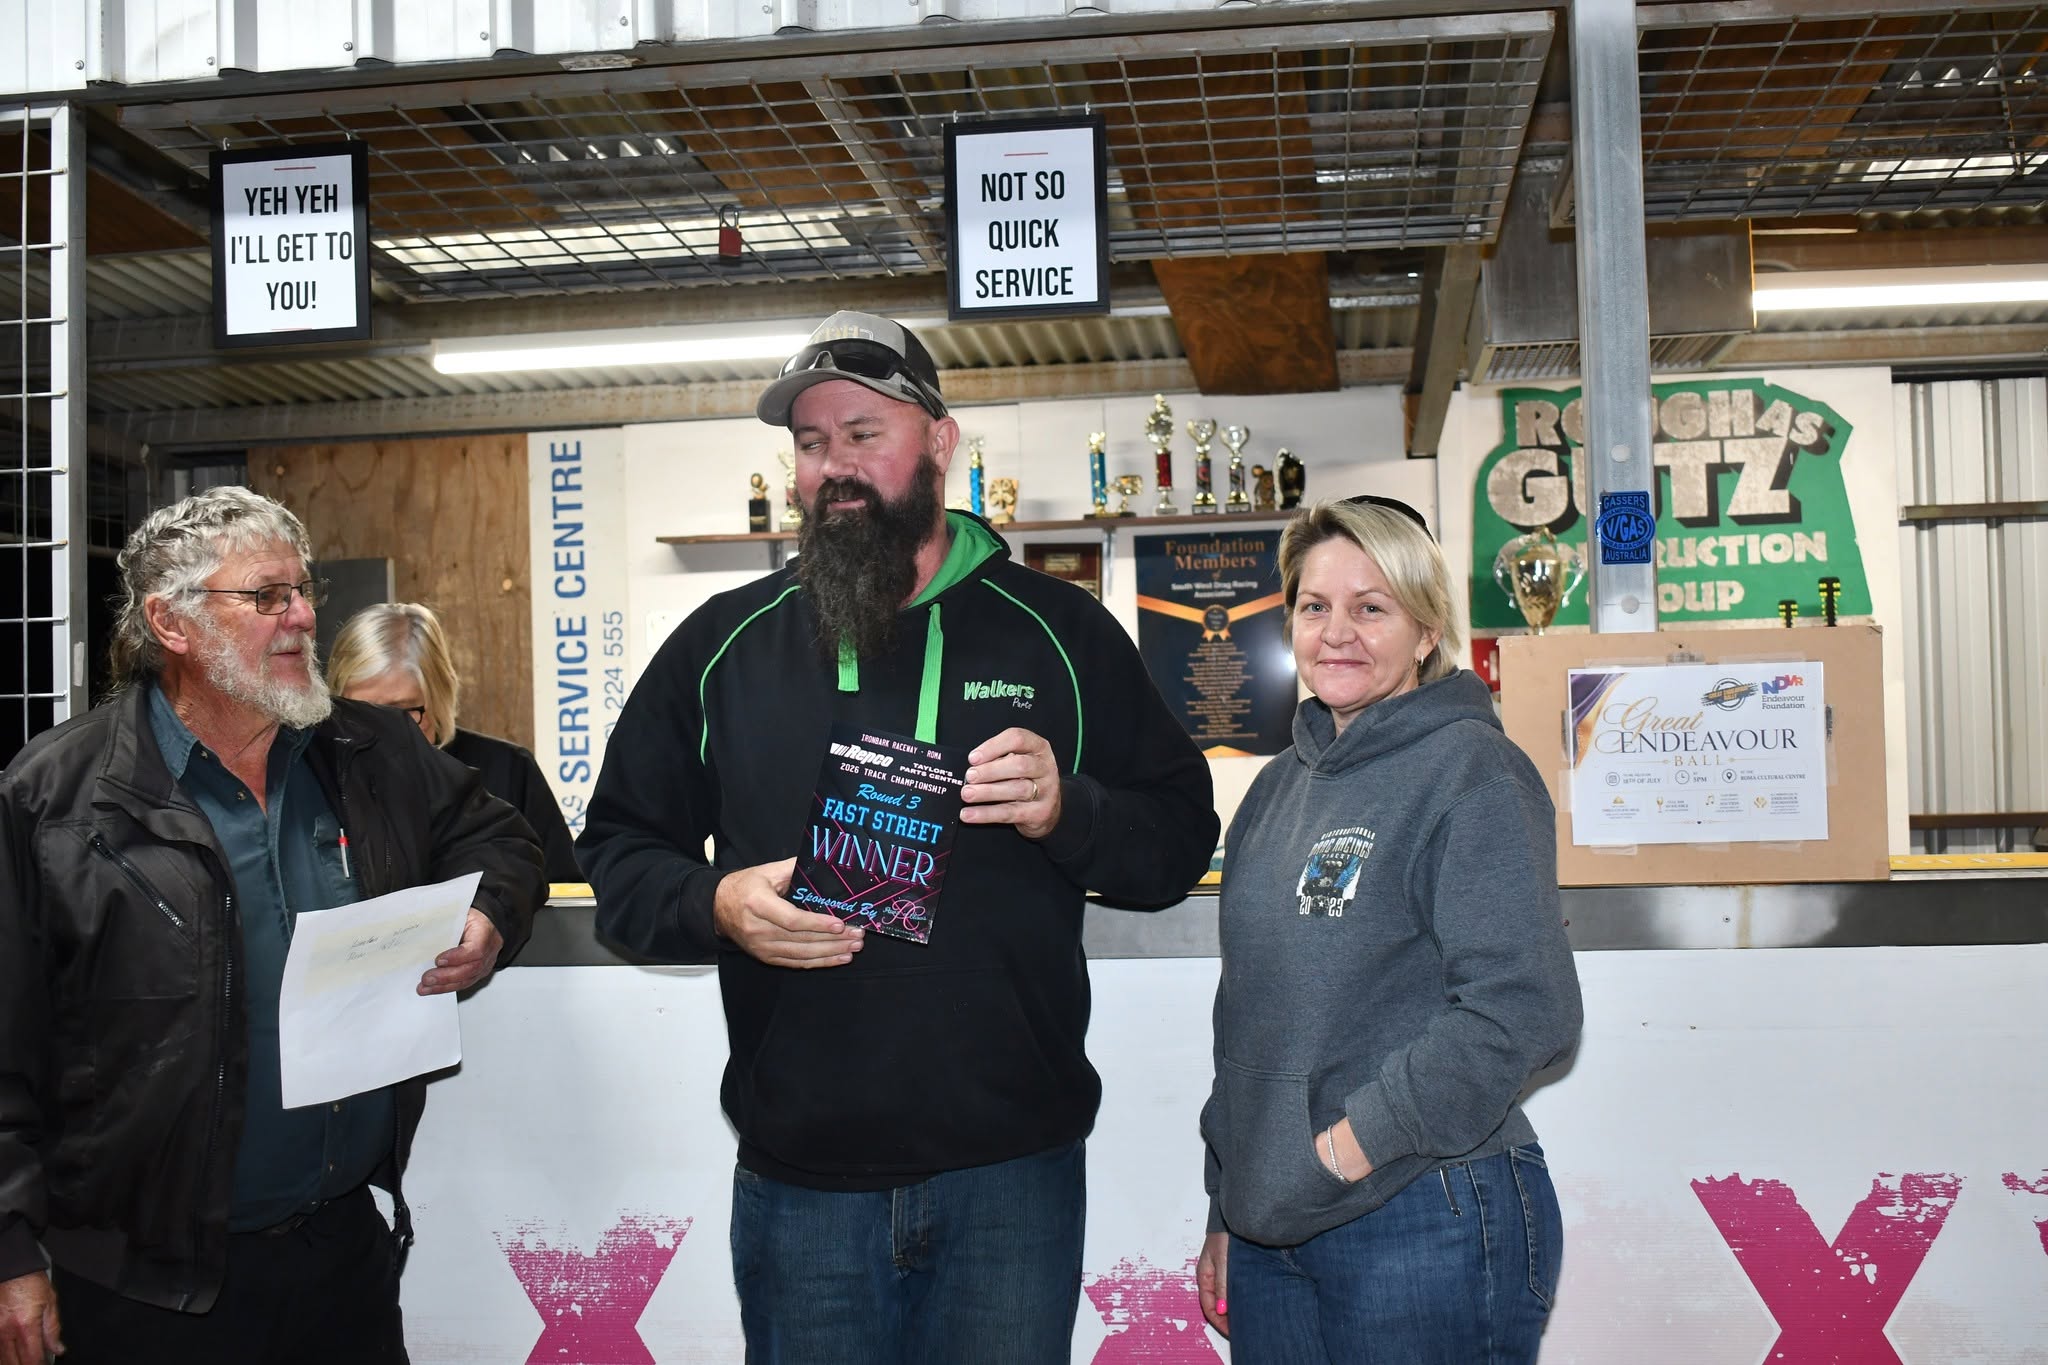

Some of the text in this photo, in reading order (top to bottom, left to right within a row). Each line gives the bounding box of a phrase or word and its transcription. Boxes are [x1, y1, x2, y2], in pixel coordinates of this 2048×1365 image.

[244, 184, 338, 216] YEH YEH
[981, 170, 1065, 202] NOT SO
[231, 231, 353, 264] I'LL GET TO
[988, 218, 1060, 252] QUICK
[266, 280, 317, 311] YOU!
[975, 266, 1074, 299] SERVICE
[1515, 388, 1826, 447] RGH AS
[1486, 436, 1791, 527] GTZ
[1603, 495, 1646, 510] GASSERS
[549, 440, 587, 600] CENTRE
[1605, 513, 1646, 542] V/GAS
[1165, 538, 1266, 556] Foundation
[1605, 548, 1648, 561] AUSTRALIA
[1174, 554, 1257, 571] Members
[603, 610, 624, 657] 555
[555, 614, 591, 784] SERVICE
[603, 666, 625, 710] 224
[963, 679, 1036, 701] Walkers
[1761, 694, 1805, 703] Endeavour
[1012, 697, 1033, 710] Parts
[1602, 696, 1705, 739] Great
[1761, 702, 1806, 710] Foundation
[844, 743, 894, 768] Repco
[861, 733, 942, 761] IRONBARK RACEWAY ROMA
[1619, 728, 1799, 754] ENDEAVOUR
[899, 765, 964, 786] PARTS CENTRE
[912, 762, 954, 777] TAYLOR'S
[1673, 754, 1723, 768] BALL
[840, 762, 948, 795] 2026 TRACK CHAMPIONSHIP
[855, 783, 922, 810] Round 3
[822, 798, 944, 845] FAST STREET
[812, 824, 936, 888] WINNER
[792, 888, 879, 920] Sponsored By
[1299, 895, 1344, 918] 20 23
